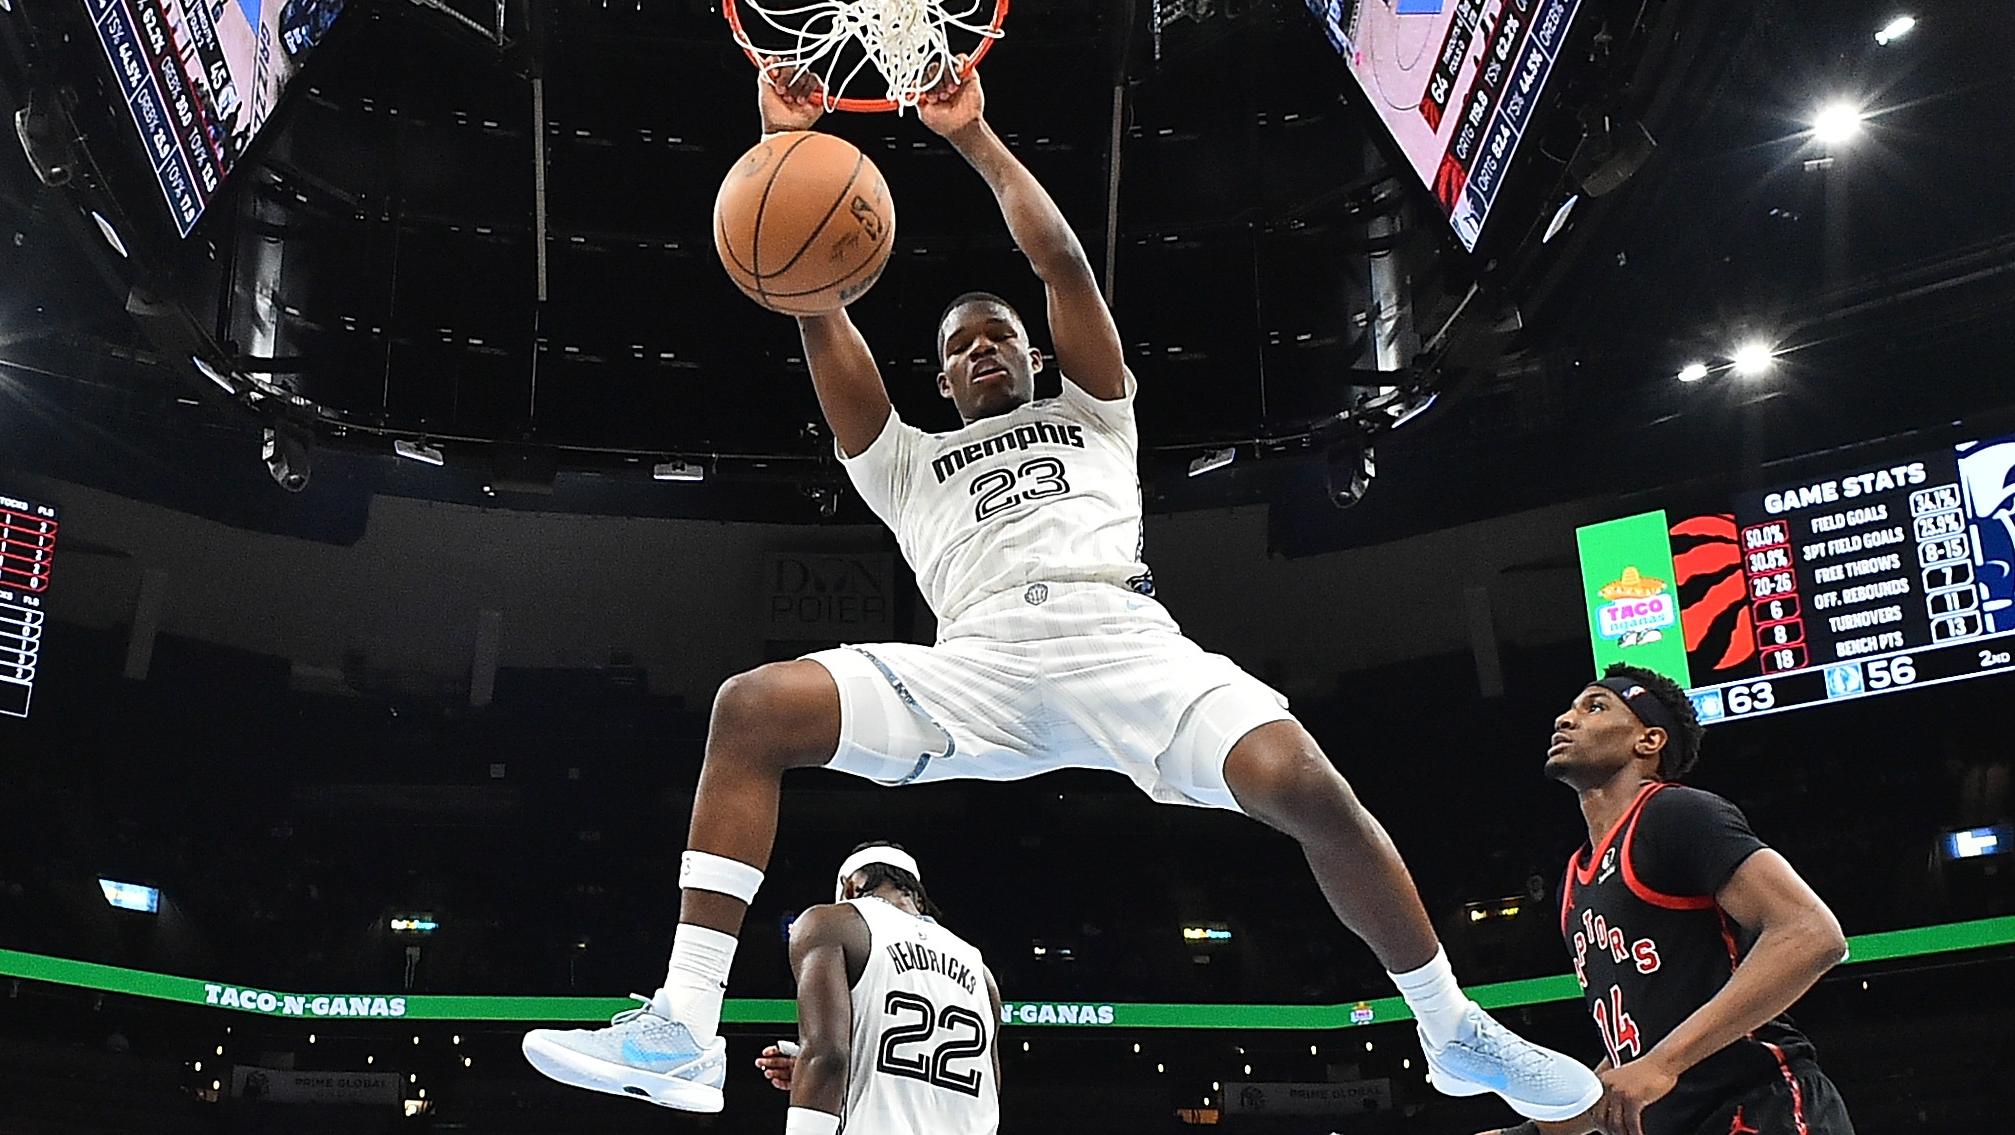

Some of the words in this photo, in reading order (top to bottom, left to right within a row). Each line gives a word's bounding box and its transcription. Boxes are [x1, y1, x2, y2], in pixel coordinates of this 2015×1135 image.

[106, 10, 125, 45] TS%
[119, 42, 142, 88] 44.5%
[143, 7, 165, 55] 62.2%
[210, 61, 227, 90] 45
[1431, 73, 1449, 104] 64
[1456, 124, 1474, 159] ORTG
[1469, 90, 1488, 127] 119.8
[1484, 57, 1501, 87] TS%
[1496, 13, 1520, 60] 62.2%
[1478, 155, 1497, 192] ORTG
[1491, 124, 1510, 159] 82.4
[1507, 91, 1525, 122] TS%
[1519, 48, 1543, 94] 44.5%
[932, 421, 1085, 484] memphis
[0, 496, 28, 511] TOCKS
[969, 456, 1071, 523] 23
[1764, 480, 1839, 514] GAME
[1842, 462, 1926, 498] STATS
[1745, 524, 1785, 549] 50.0%
[1811, 513, 1846, 533] FIELD
[1846, 504, 1888, 526] GOALS
[1915, 488, 1957, 513] 34.1%
[1749, 548, 1788, 572] 30.8%
[1802, 542, 1826, 561] 3PT
[1827, 536, 1862, 556] FIELD
[1863, 527, 1905, 549] GOALS
[1918, 513, 1960, 537] 25.9%
[1753, 572, 1792, 597] 20-26
[1815, 565, 1845, 584] FREE
[1845, 553, 1901, 578] THROWS
[1924, 539, 1963, 562] 8-15
[1769, 600, 1783, 620] 6
[1814, 591, 1842, 610] OFF.
[1842, 578, 1910, 604] REBOUNDS
[1940, 566, 1953, 586] 7
[1607, 599, 1663, 621] TACO
[1774, 625, 1787, 644] 8
[1828, 605, 1903, 633] TURNOVERS
[1944, 592, 1960, 612] 11
[1774, 649, 1794, 670] 18
[1836, 636, 1878, 658] BENCH
[1878, 631, 1904, 650] PTS
[1946, 617, 1967, 637] 13
[1727, 682, 1775, 713] 63
[1868, 656, 1916, 689] 56
[1979, 650, 2011, 667] 2ND
[886, 941, 977, 995] HENDRICKS
[1573, 908, 1661, 988] PTORS
[205, 984, 406, 1016] TACO-N-GANAS
[1000, 1004, 1114, 1024] N-GANAS
[1593, 984, 1641, 1069] 14
[876, 990, 987, 1098] 22
[295, 1077, 331, 1088] PRIME
